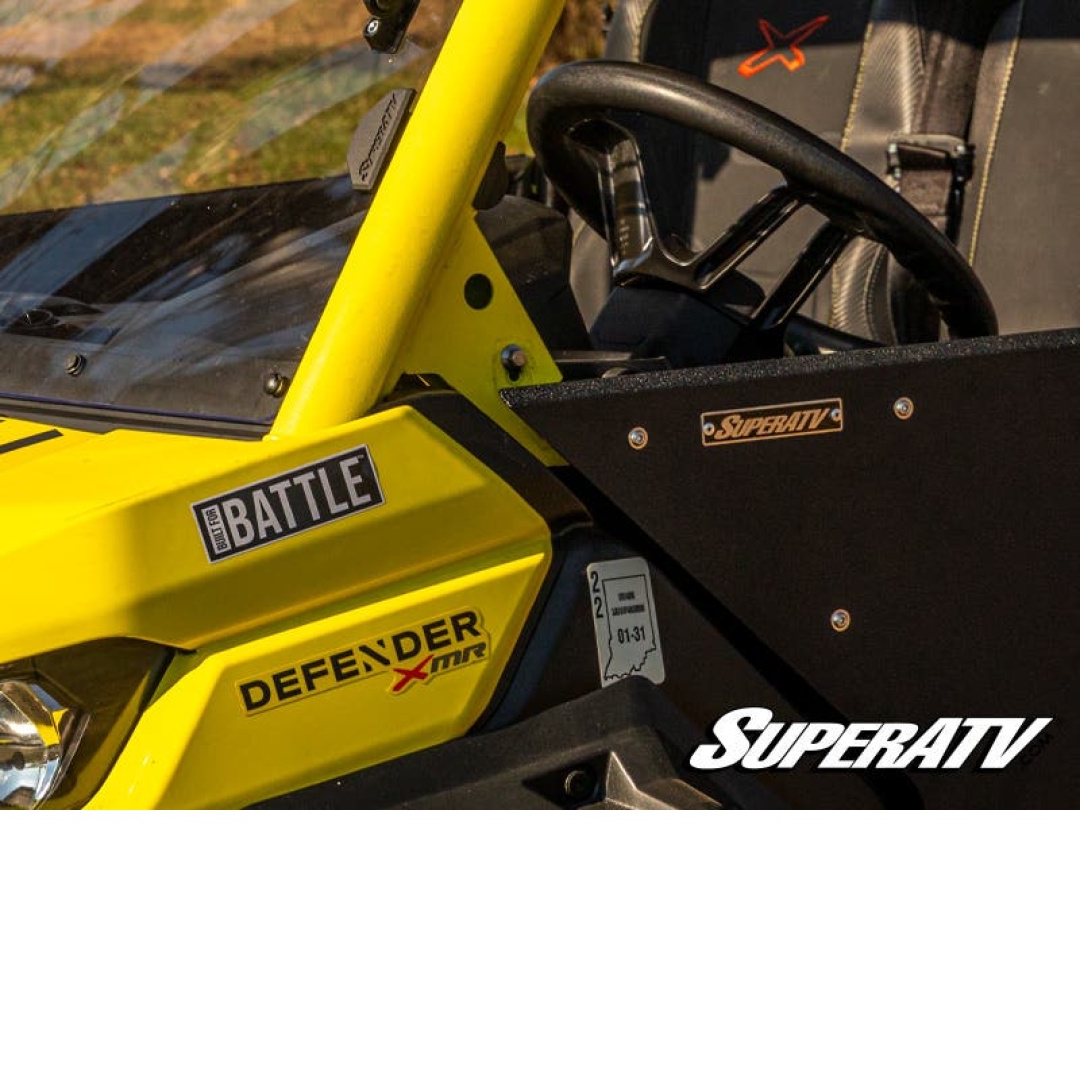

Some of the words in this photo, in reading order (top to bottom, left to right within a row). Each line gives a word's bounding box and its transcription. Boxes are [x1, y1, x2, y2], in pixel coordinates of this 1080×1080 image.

[222, 456, 372, 548] BATTLE
[206, 508, 221, 526] FOR
[212, 527, 228, 551] BUILT
[617, 625, 646, 645] 01-31
[239, 610, 482, 711] DEFENDER
